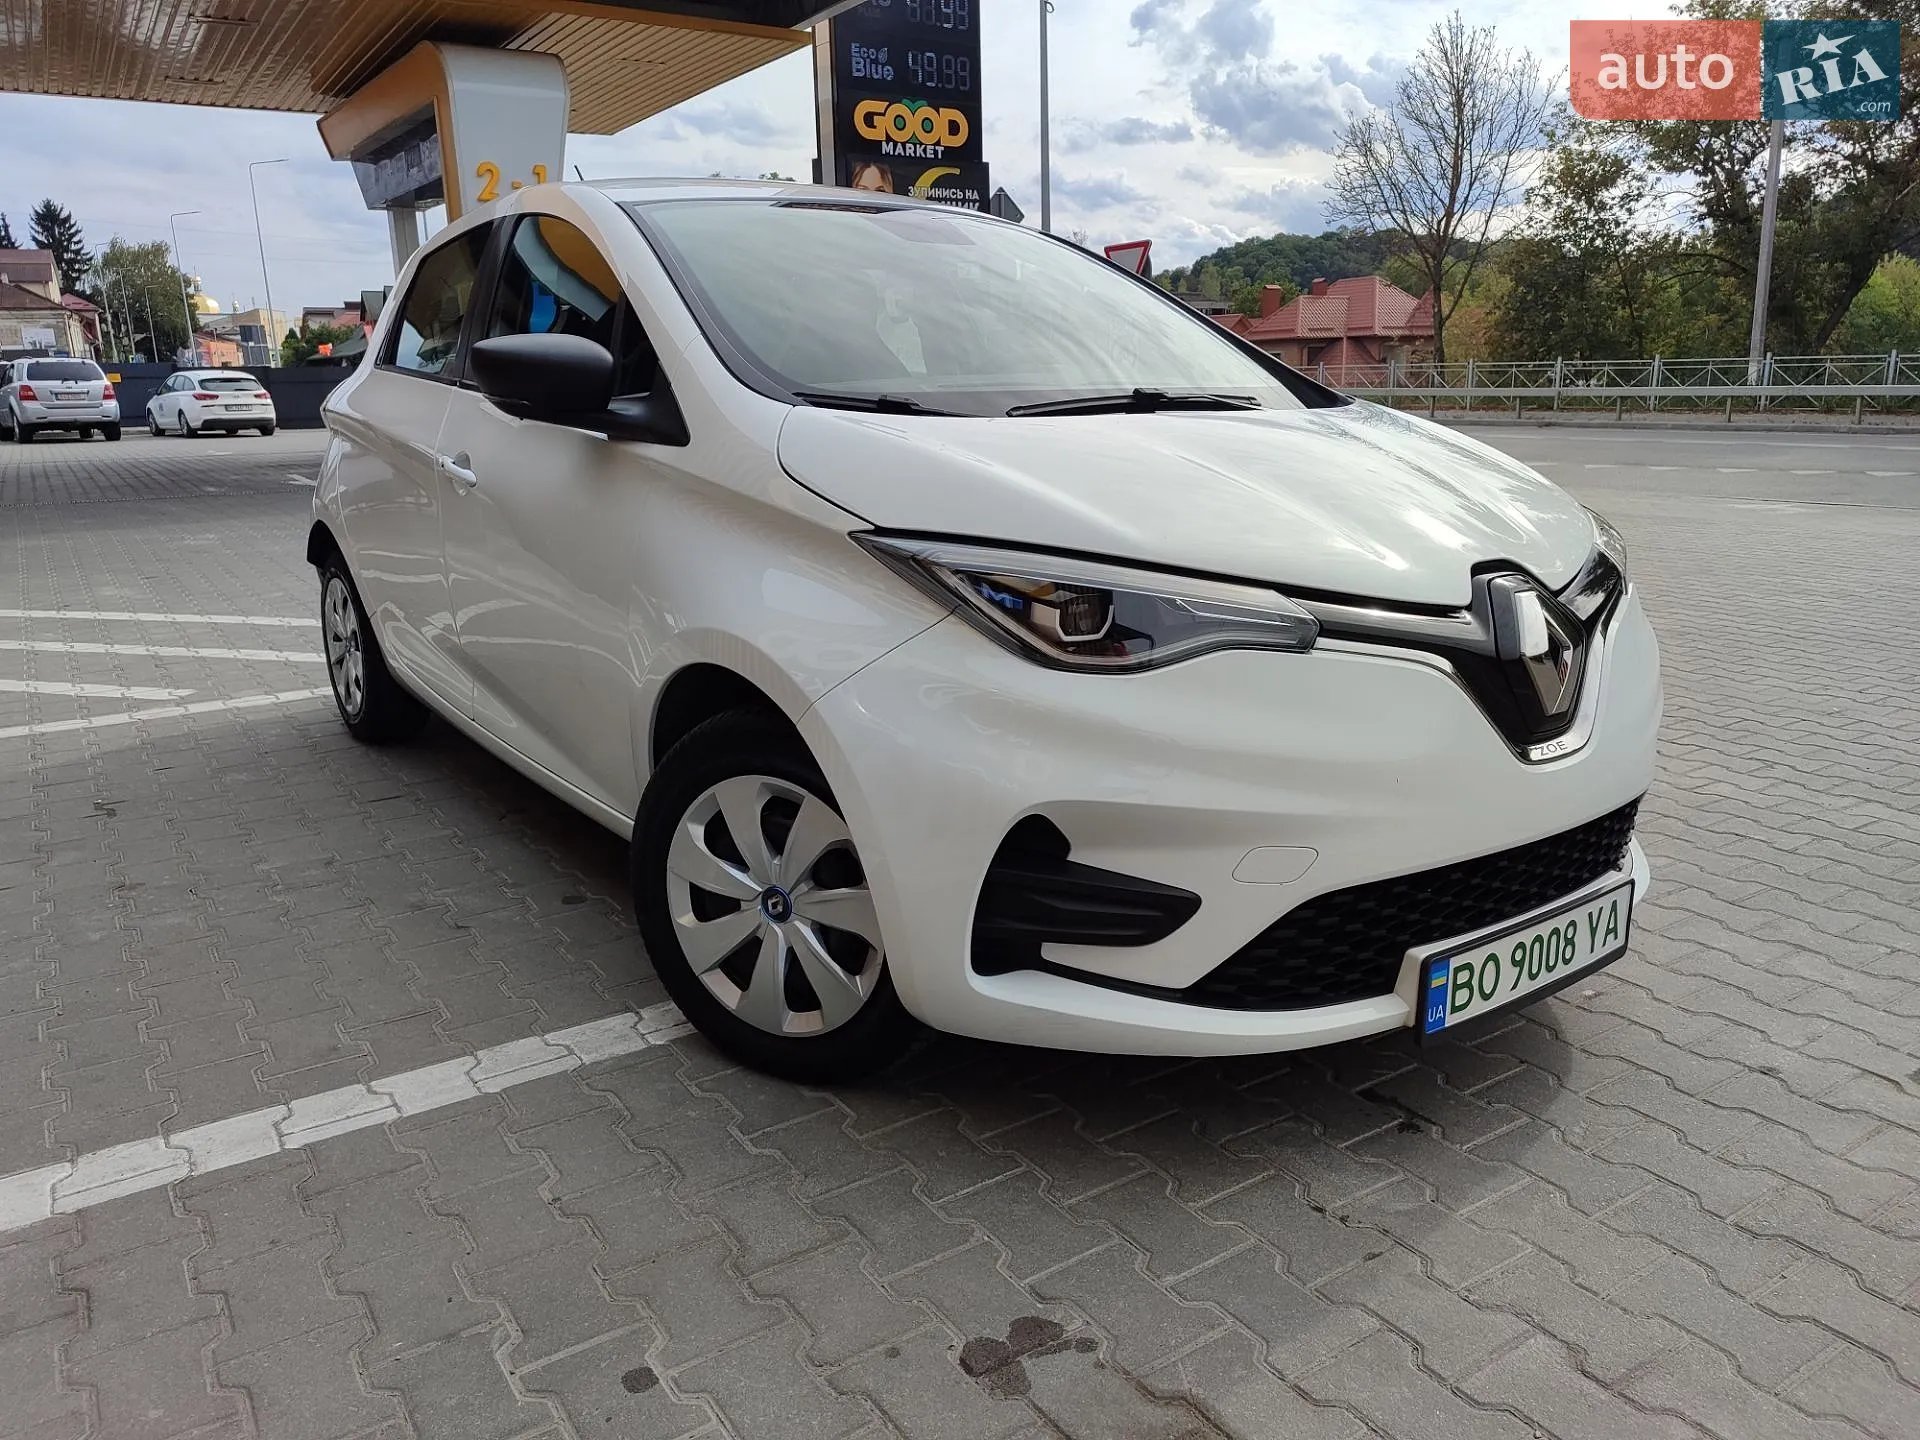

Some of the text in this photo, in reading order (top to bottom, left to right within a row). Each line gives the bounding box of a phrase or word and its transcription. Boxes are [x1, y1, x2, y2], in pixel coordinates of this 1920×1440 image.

[851, 42, 877, 60] Eco
[852, 57, 895, 80] Blue
[853, 99, 969, 147] GOOD
[881, 141, 945, 160] MARKET
[907, 185, 980, 200] ЗУПИНИСЬ НА
[1534, 740, 1568, 757] ZOE
[1450, 899, 1619, 1015] BO 9008 YA
[1427, 1004, 1445, 1023] UA
